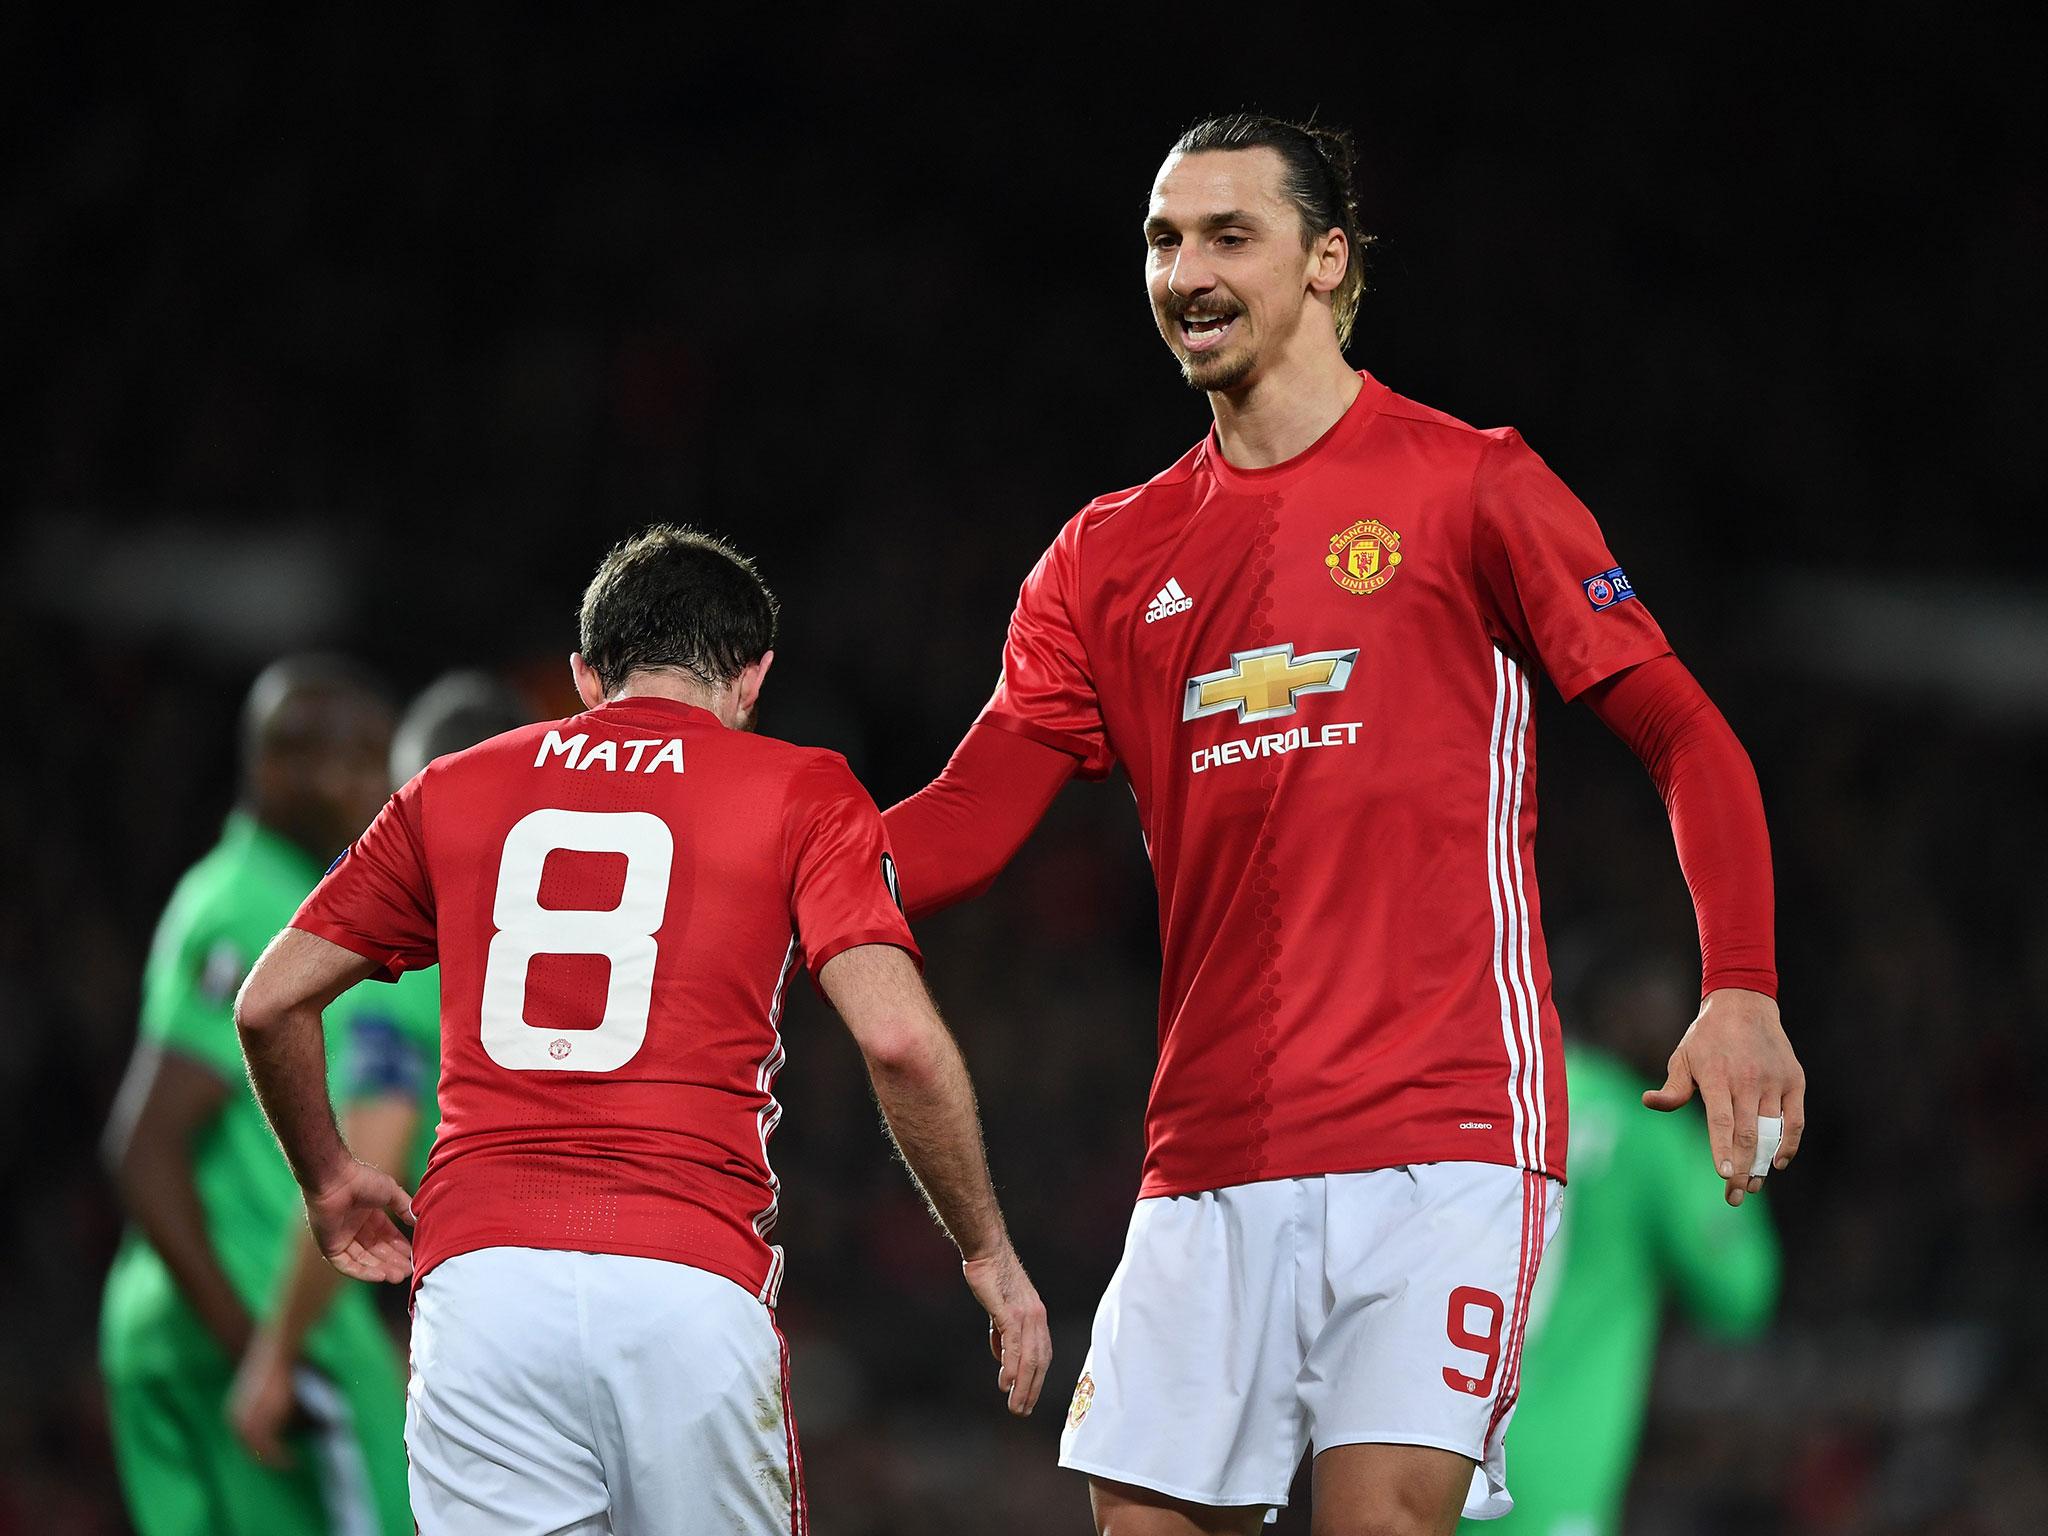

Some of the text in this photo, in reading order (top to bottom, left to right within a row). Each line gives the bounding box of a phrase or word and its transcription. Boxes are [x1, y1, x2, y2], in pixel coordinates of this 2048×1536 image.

[1335, 525, 1396, 550] MANCHESTER
[1341, 576, 1385, 590] UNITED
[1145, 596, 1193, 624] adidas
[534, 730, 685, 774] MATA
[1191, 722, 1363, 774] CHEVROLET
[480, 808, 674, 1073] 8
[1459, 1121, 1493, 1130] adizero
[1442, 1285, 1505, 1399] 9
